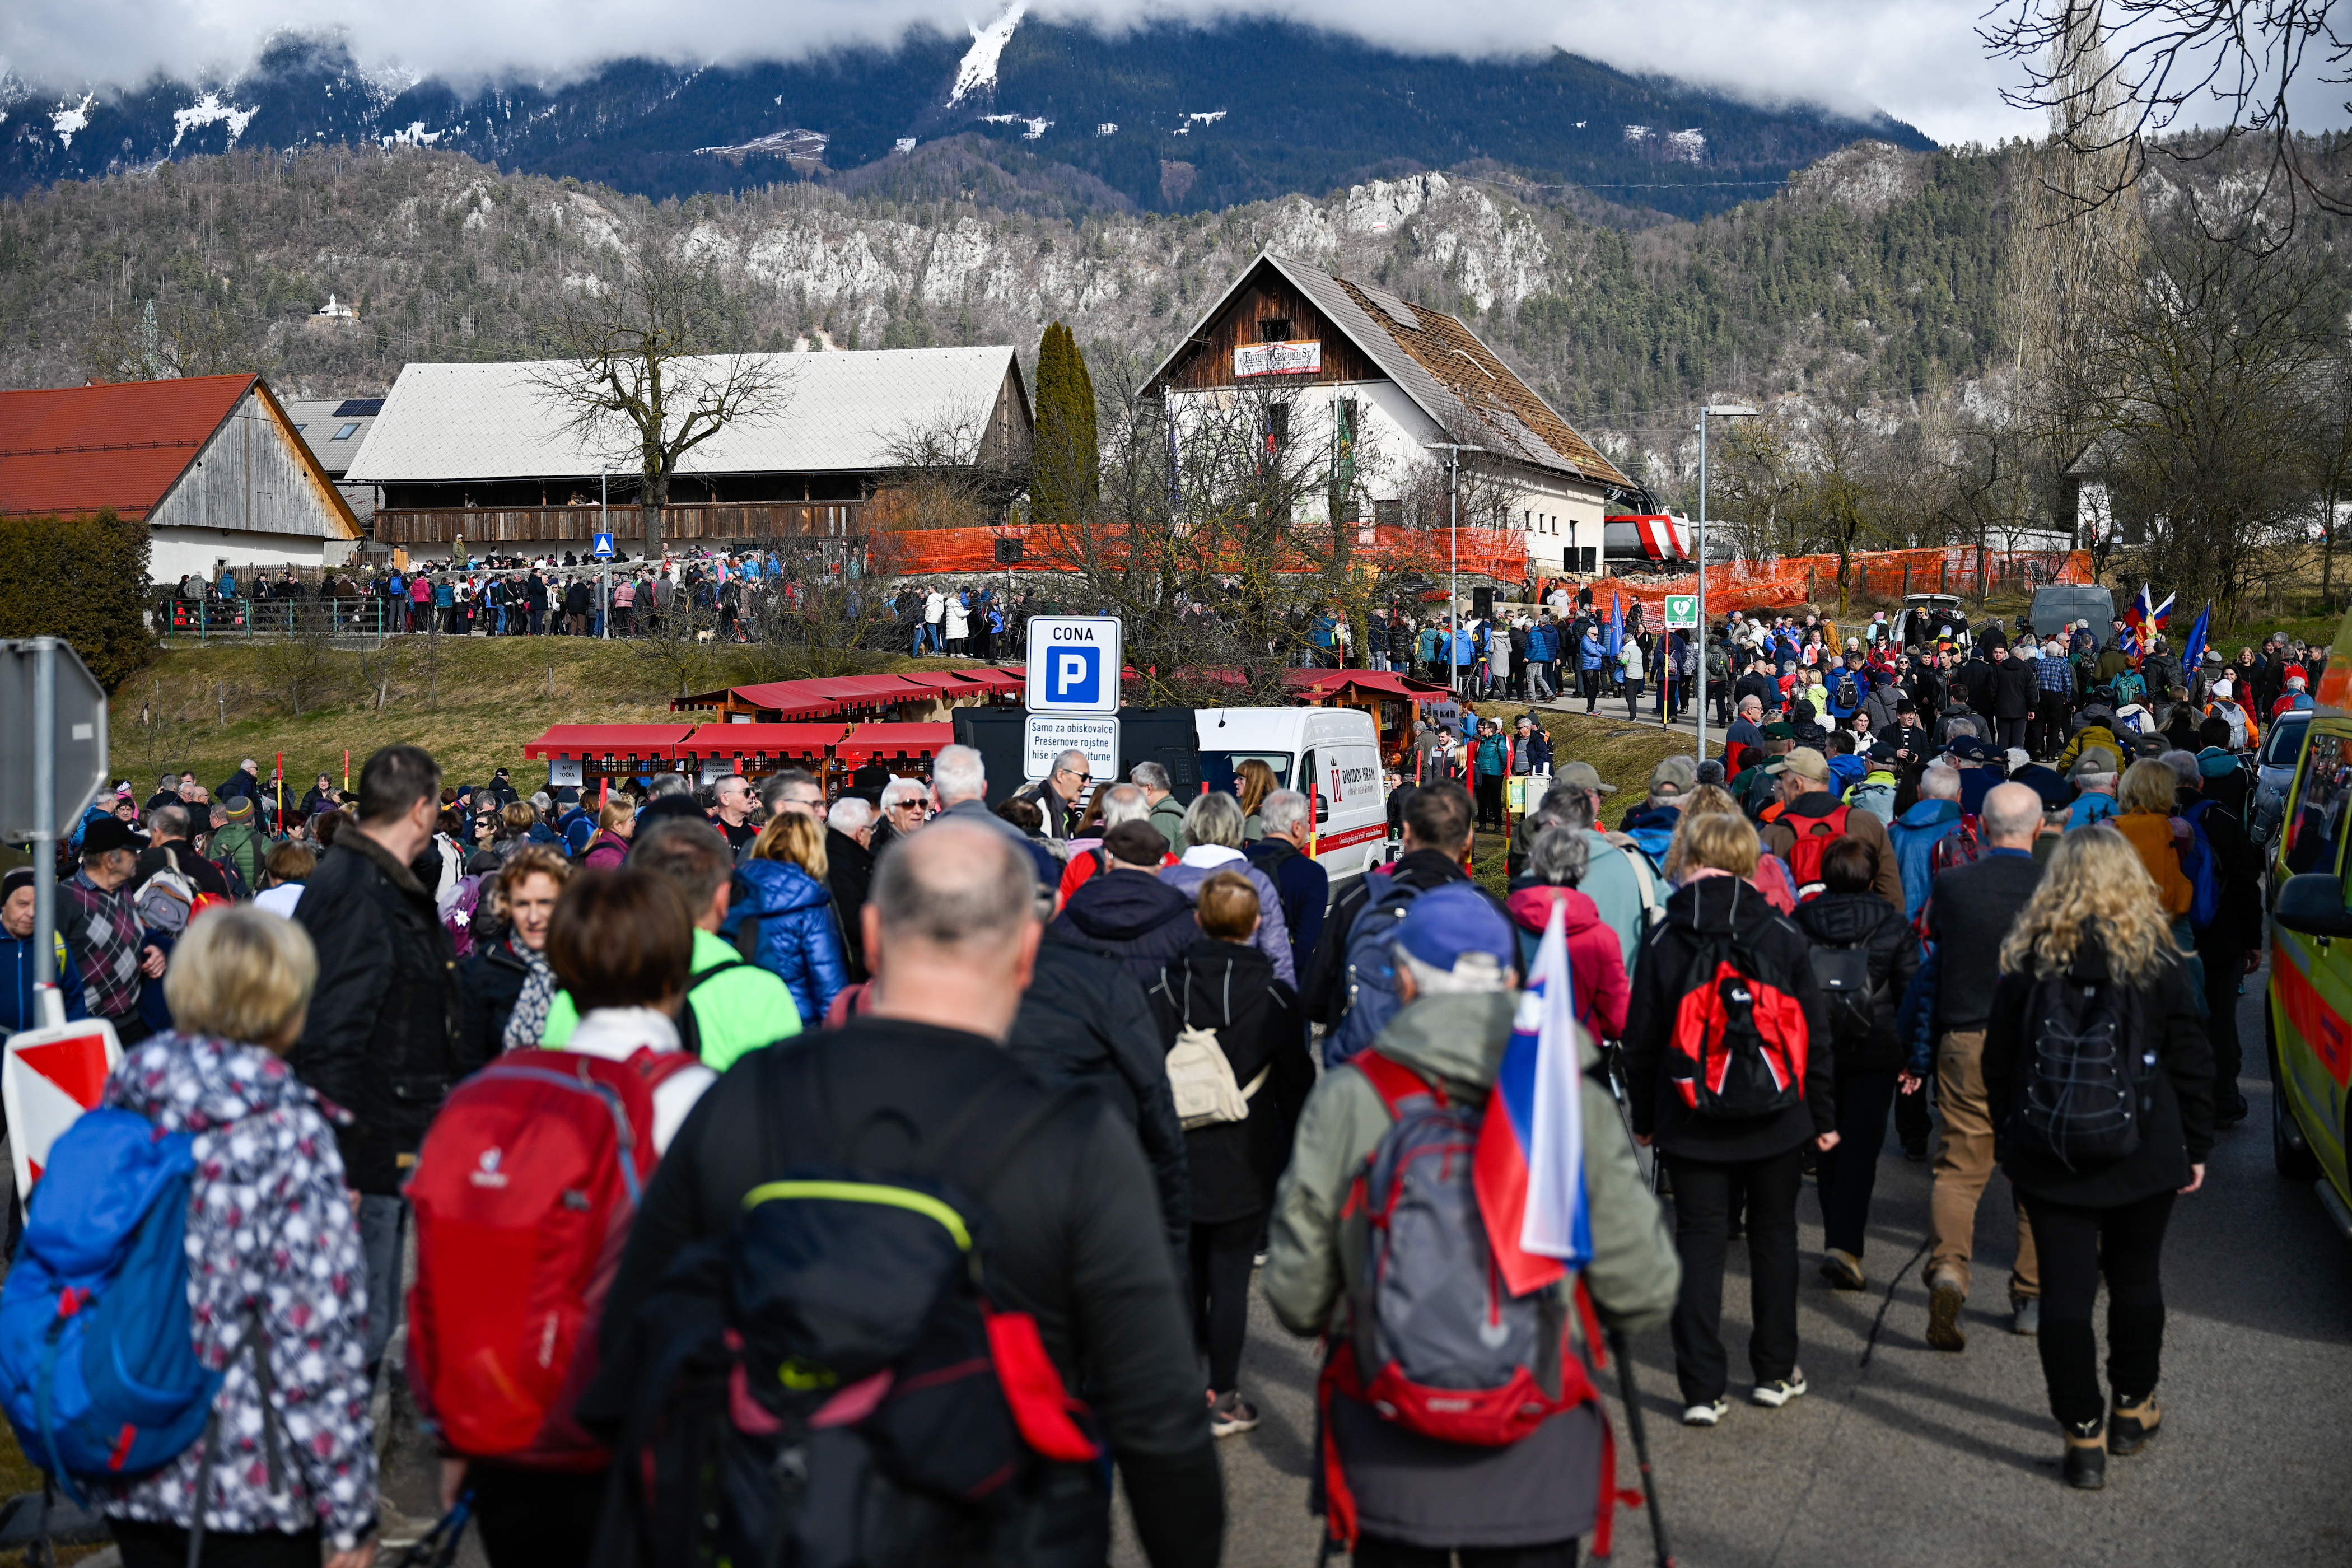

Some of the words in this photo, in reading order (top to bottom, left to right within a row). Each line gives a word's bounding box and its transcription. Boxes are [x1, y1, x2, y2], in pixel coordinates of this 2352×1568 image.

[1053, 627, 1094, 641] CONA
[1058, 654, 1087, 694] P
[1032, 722, 1053, 732] Samo
[1067, 724, 1113, 734] obiskovalce
[1035, 736, 1078, 746] Prešernove
[1081, 738, 1109, 749] rojstne
[1032, 750, 1048, 759] hiše
[1342, 768, 1362, 784] DAVIDOV
[1362, 766, 1375, 781] HRAM
